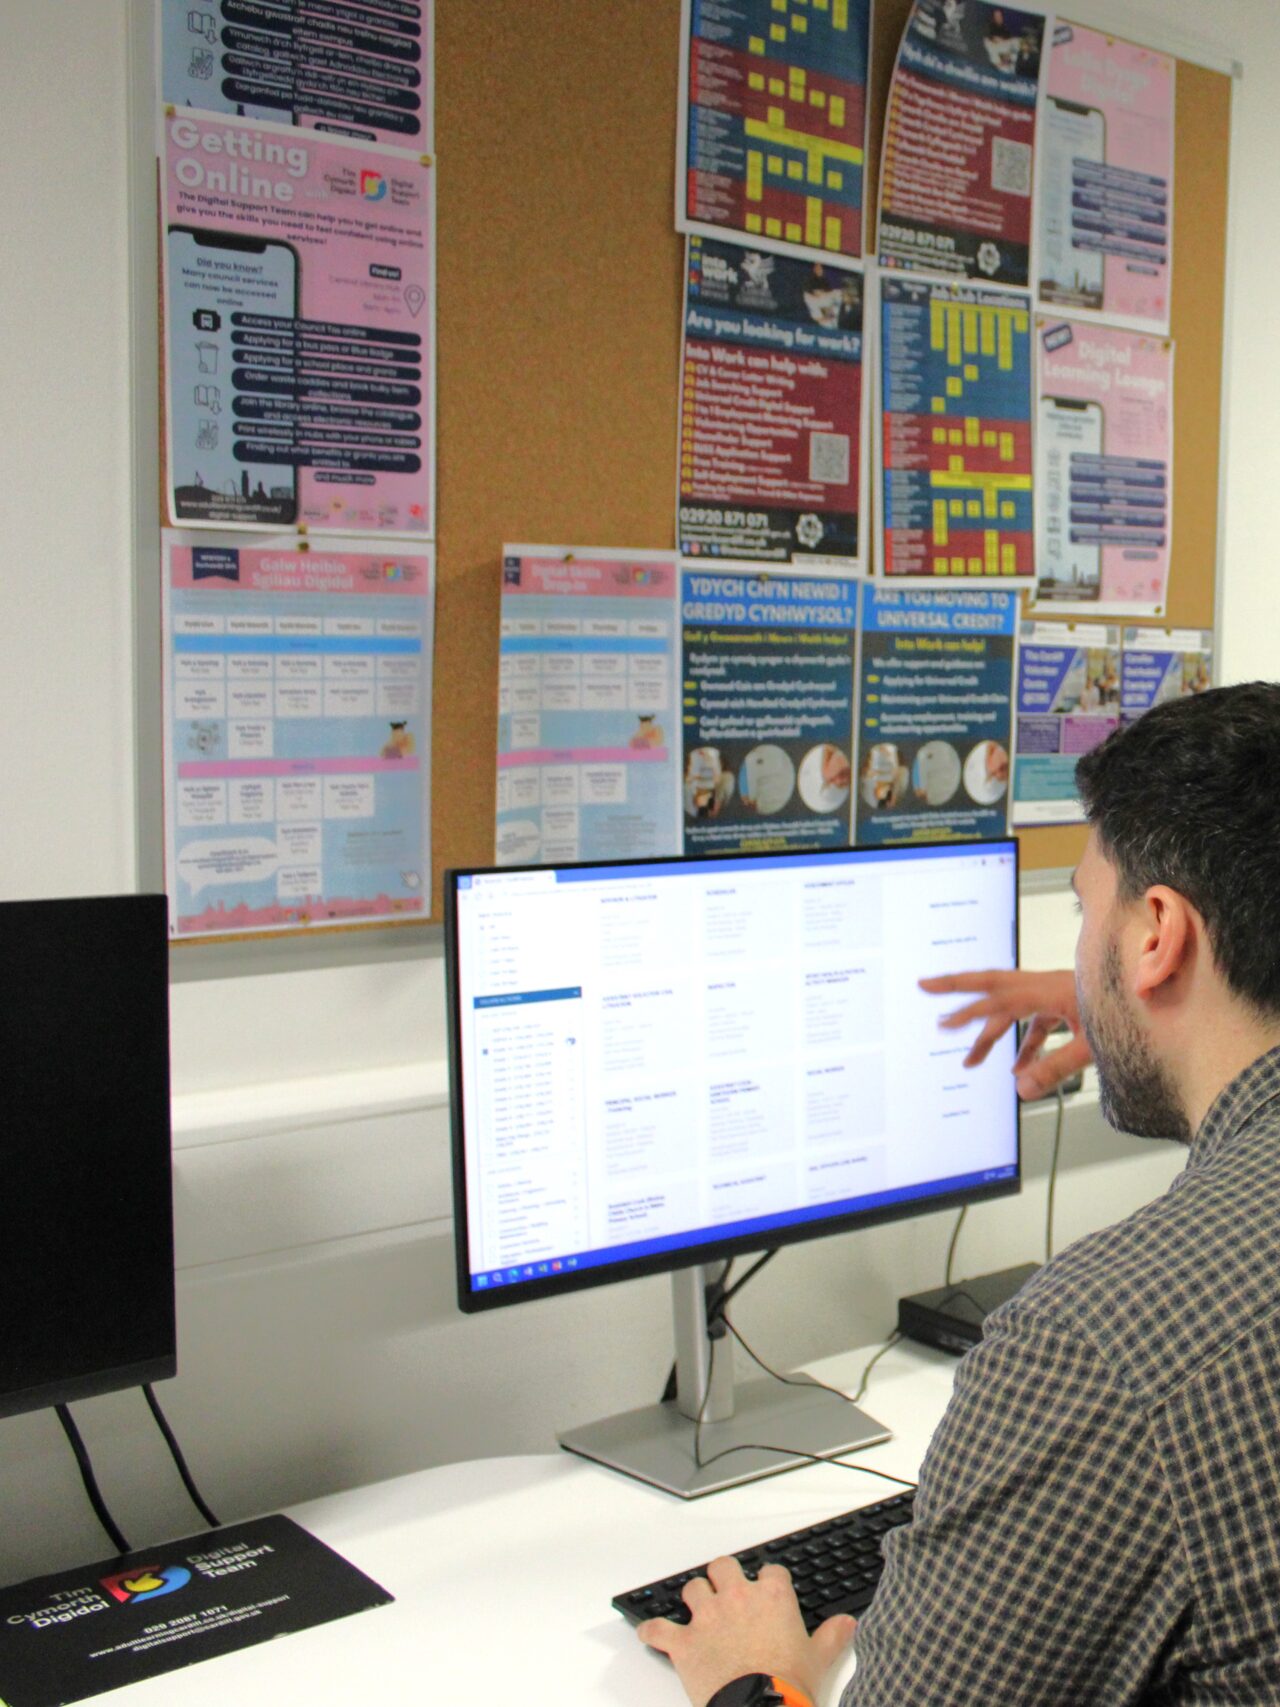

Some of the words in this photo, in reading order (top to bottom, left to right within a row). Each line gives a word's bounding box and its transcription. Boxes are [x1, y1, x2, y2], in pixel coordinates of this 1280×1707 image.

[171, 119, 308, 178] Getting
[176, 157, 294, 202] Online
[176, 204, 196, 214] give
[198, 208, 216, 217] you
[218, 210, 234, 220] the
[236, 213, 259, 223] skills
[261, 218, 279, 227] you
[281, 219, 304, 229] need
[305, 222, 314, 230] to
[179, 191, 195, 201] The
[198, 195, 229, 207] Digital
[231, 200, 269, 212] Support
[270, 206, 297, 217] Team
[298, 211, 315, 219] can
[317, 213, 336, 225] help
[182, 268, 206, 279] Many
[207, 272, 241, 282] council
[242, 277, 278, 287] services
[197, 257, 212, 267] Did
[213, 262, 232, 272] you
[233, 262, 263, 275] know?
[184, 281, 201, 289] can
[202, 283, 220, 291] now
[222, 285, 233, 294] be
[235, 287, 277, 299] accessed
[241, 315, 272, 327] Access
[273, 320, 293, 331] your
[687, 310, 712, 330] Are
[715, 319, 741, 336] you
[742, 318, 794, 347] looking
[795, 327, 816, 345] for
[817, 333, 861, 351] work?
[243, 334, 280, 348] Applying
[282, 337, 293, 347] for
[243, 353, 280, 367] Applying
[282, 356, 293, 366] for
[686, 343, 710, 360] Into
[711, 347, 746, 366] Work
[680, 507, 723, 524] 02920
[259, 557, 297, 573] Galw
[300, 558, 348, 575] Heibio
[690, 577, 743, 598] YDYCH
[746, 579, 790, 599] CHI'N
[791, 581, 839, 601] NEWID
[904, 591, 933, 607] YOU
[935, 591, 988, 609] MOVING
[991, 593, 1009, 609] TO
[683, 601, 746, 622] GREDYD
[749, 603, 852, 625] CYNHWYSOL?
[877, 609, 950, 629] UNIVERSAL
[952, 612, 1005, 630] CREDIT?
[186, 1542, 249, 1565] Digital
[194, 1544, 275, 1572] Support
[201, 1559, 258, 1578] Team
[48, 1586, 94, 1601] Tim
[6, 1593, 102, 1625] Cymorth
[32, 1599, 111, 1629] Digidol
[143, 1622, 168, 1635] 029
[169, 1613, 198, 1628] 2087
[201, 1604, 229, 1619] 1071
